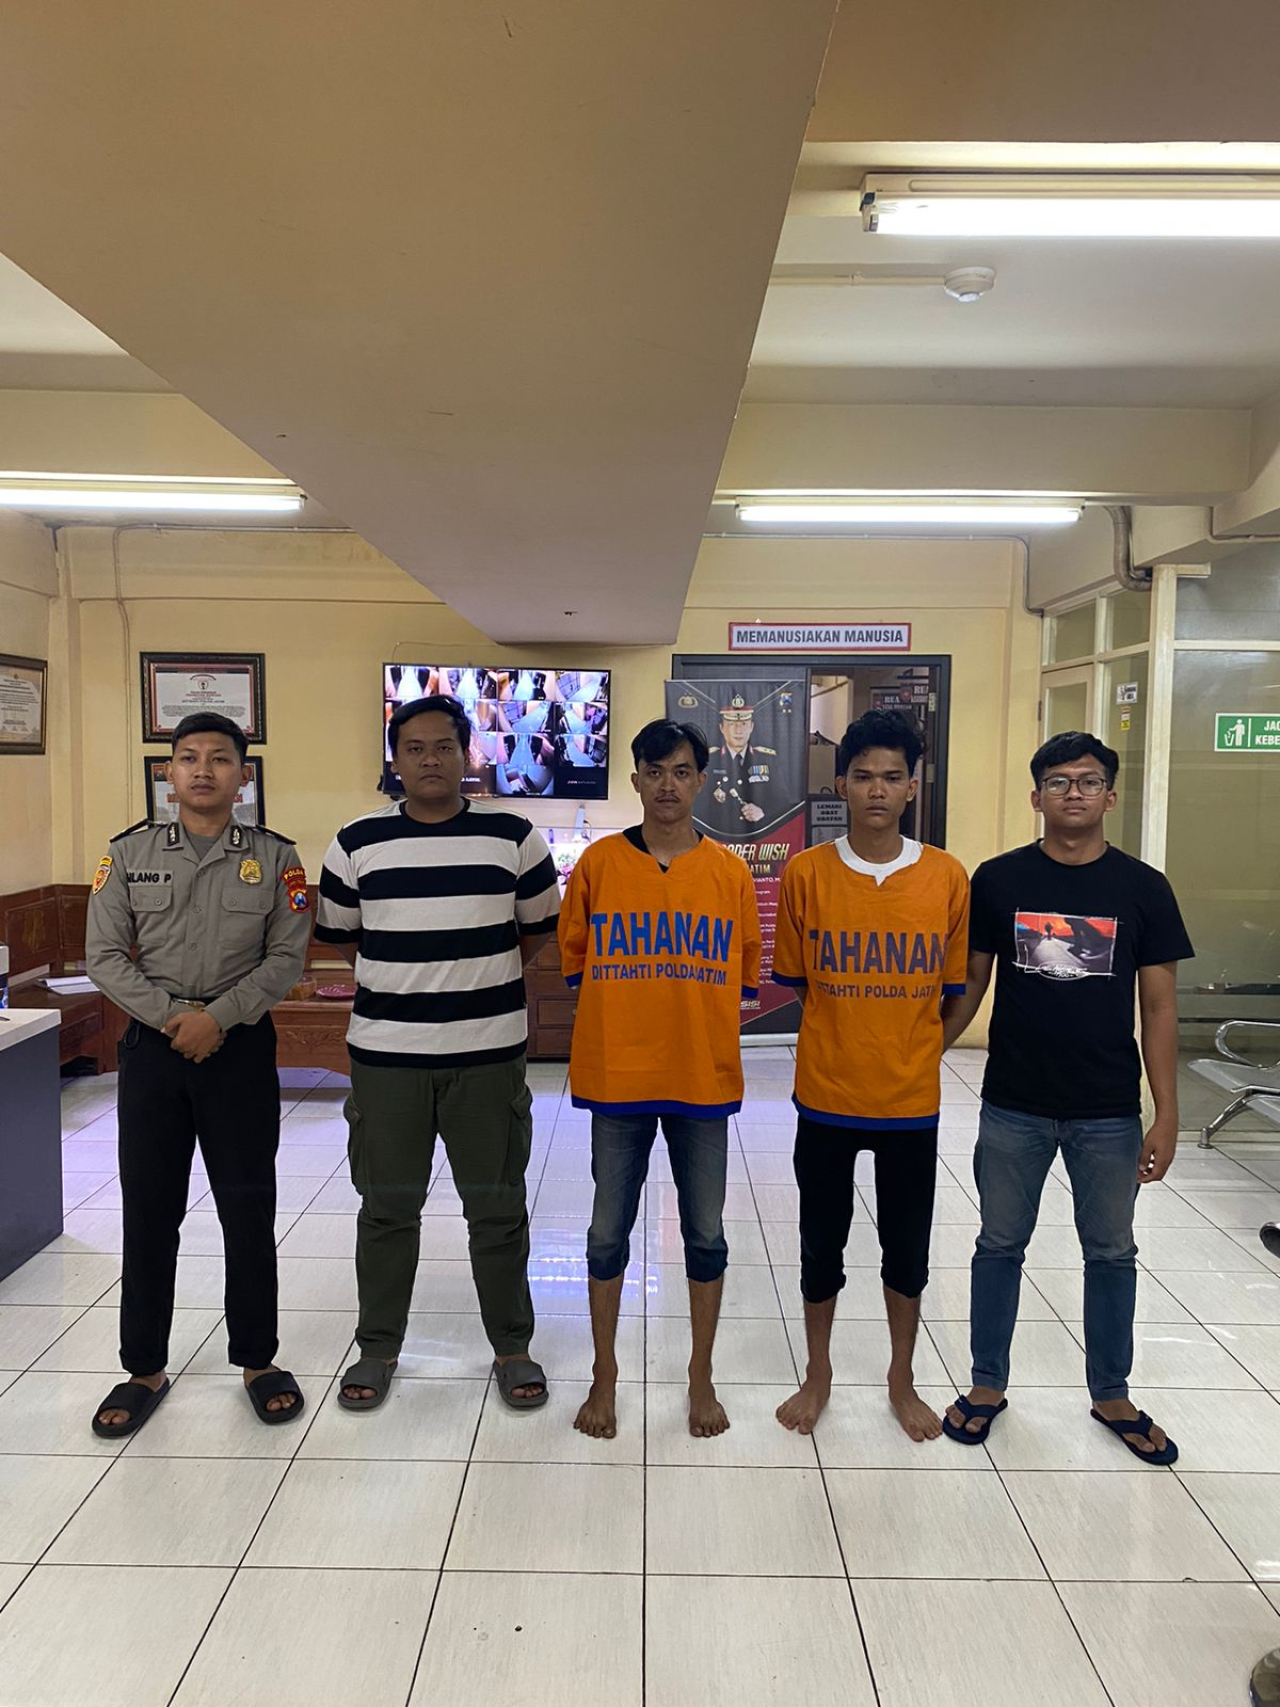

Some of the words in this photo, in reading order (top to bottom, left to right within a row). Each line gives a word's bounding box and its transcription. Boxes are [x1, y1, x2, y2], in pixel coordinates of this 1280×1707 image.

[736, 630, 840, 643] MEMANUSIAKAN
[845, 630, 903, 642] MANUSIA
[758, 843, 790, 861] WISH
[750, 864, 771, 874] ATIM
[164, 873, 171, 883] P
[591, 912, 733, 962] TAHANAN
[809, 929, 949, 974] TAHANAN
[592, 964, 651, 980] DITTAHTI
[865, 985, 907, 998] POLDA
